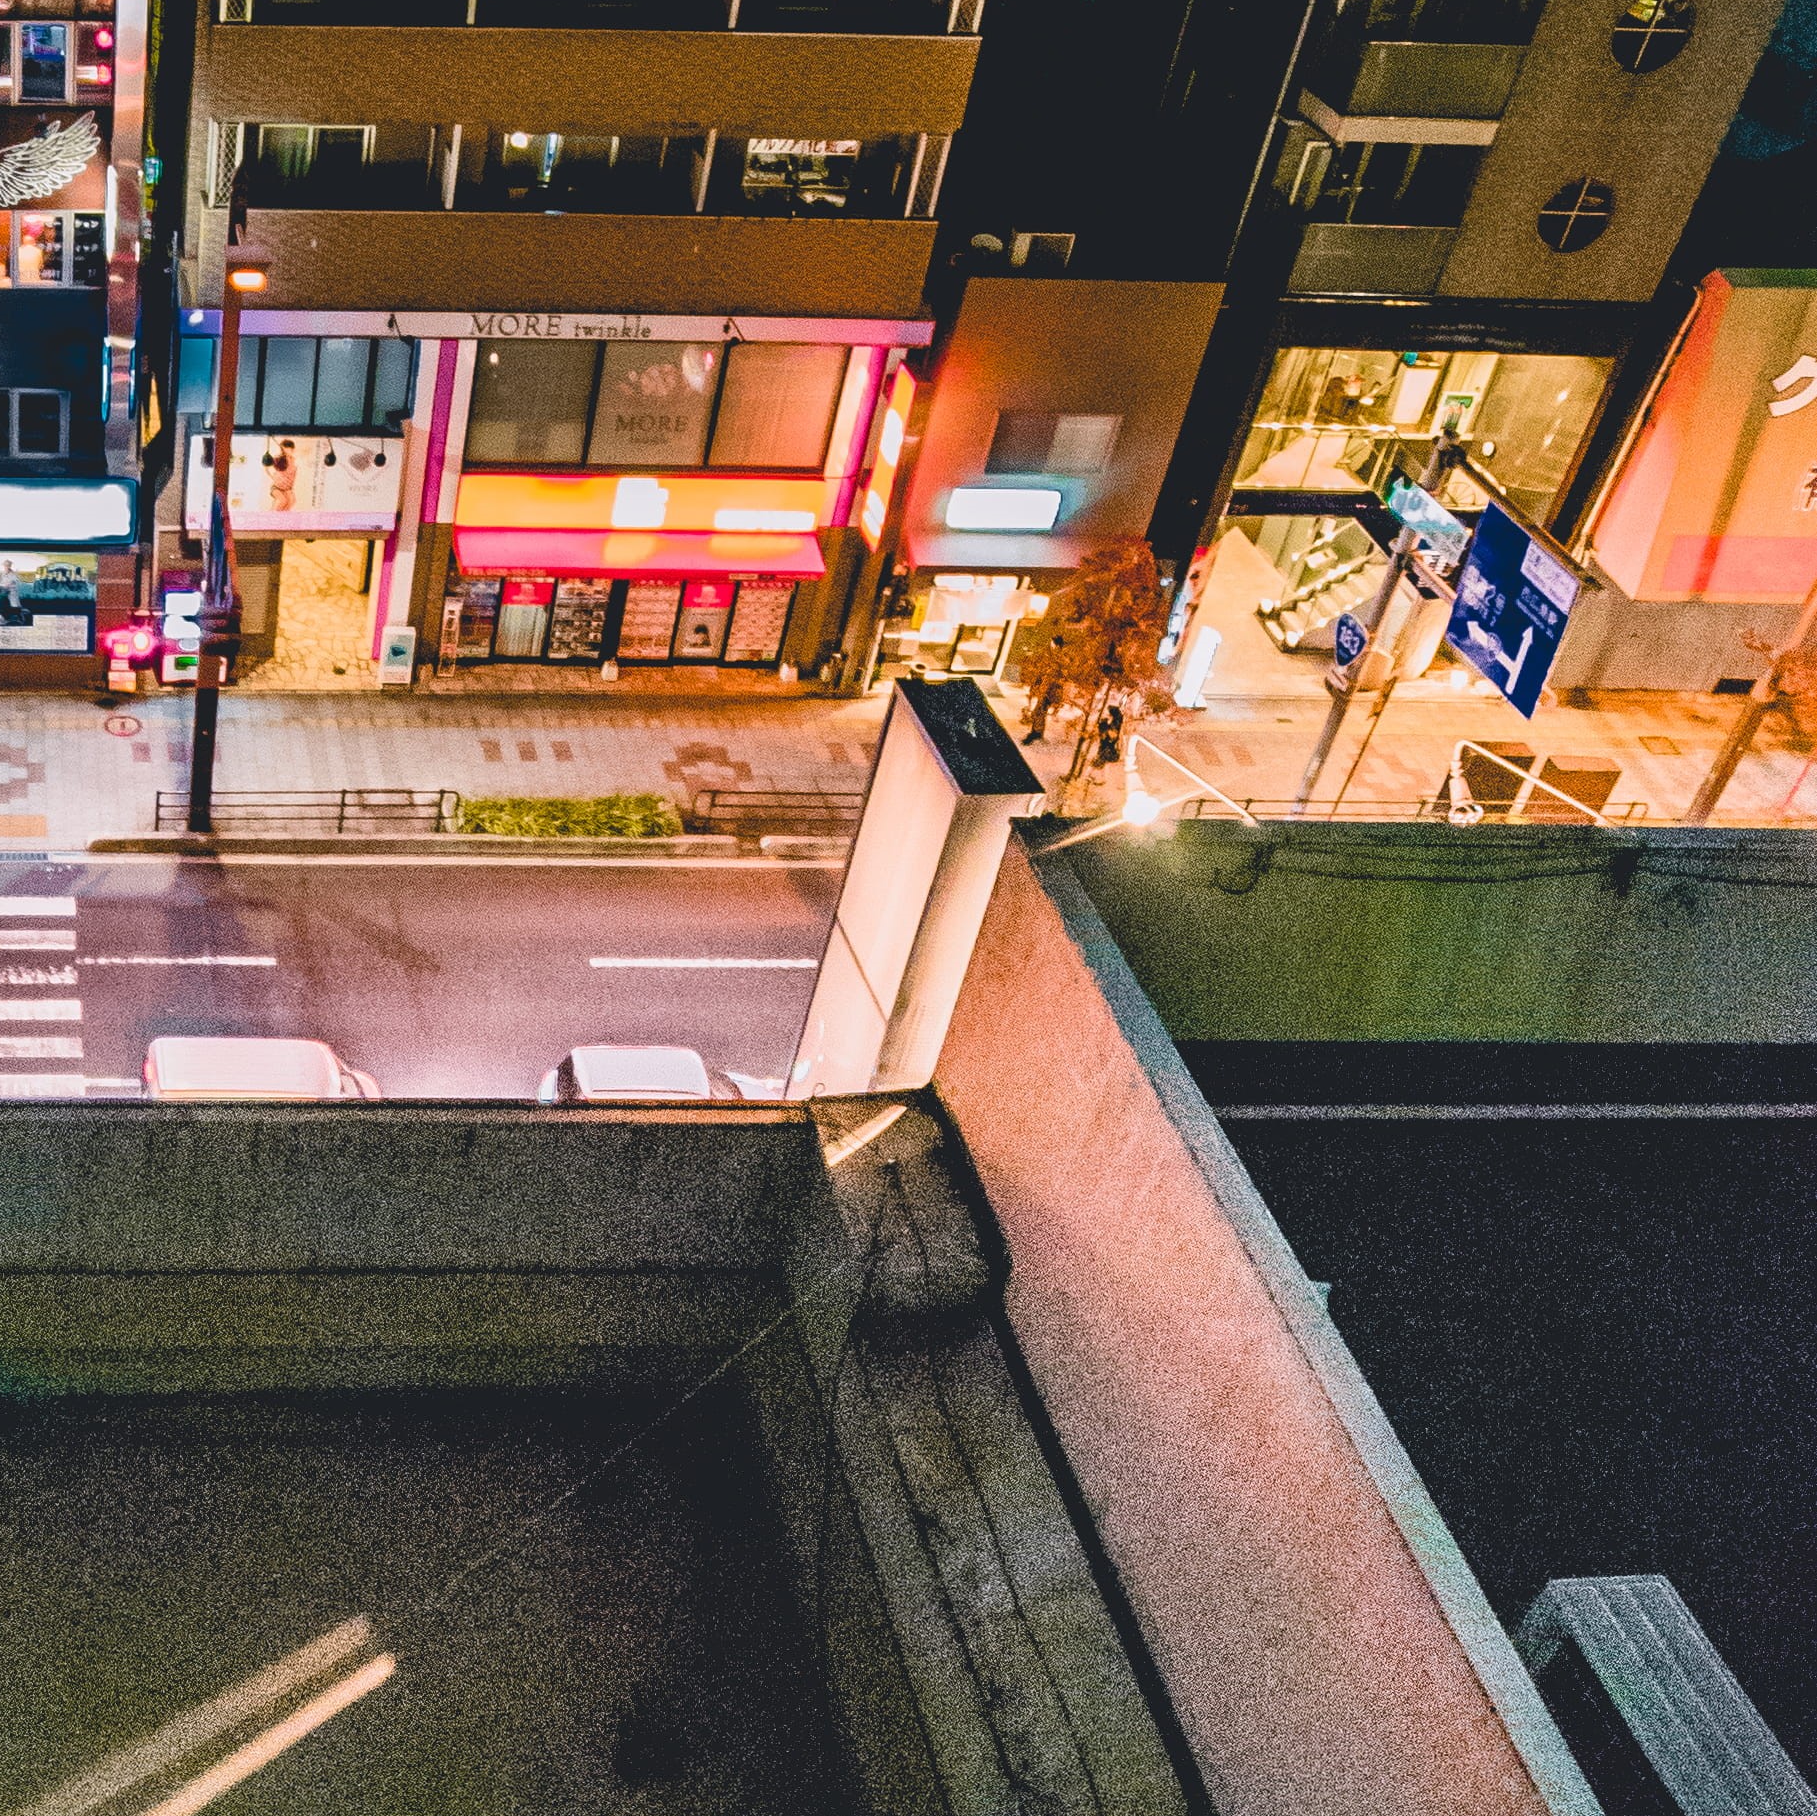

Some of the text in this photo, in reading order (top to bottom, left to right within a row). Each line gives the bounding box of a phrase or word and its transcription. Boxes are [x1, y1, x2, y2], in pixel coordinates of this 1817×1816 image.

[470, 314, 651, 339] MORE twinkle
[615, 414, 688, 433] MORE
